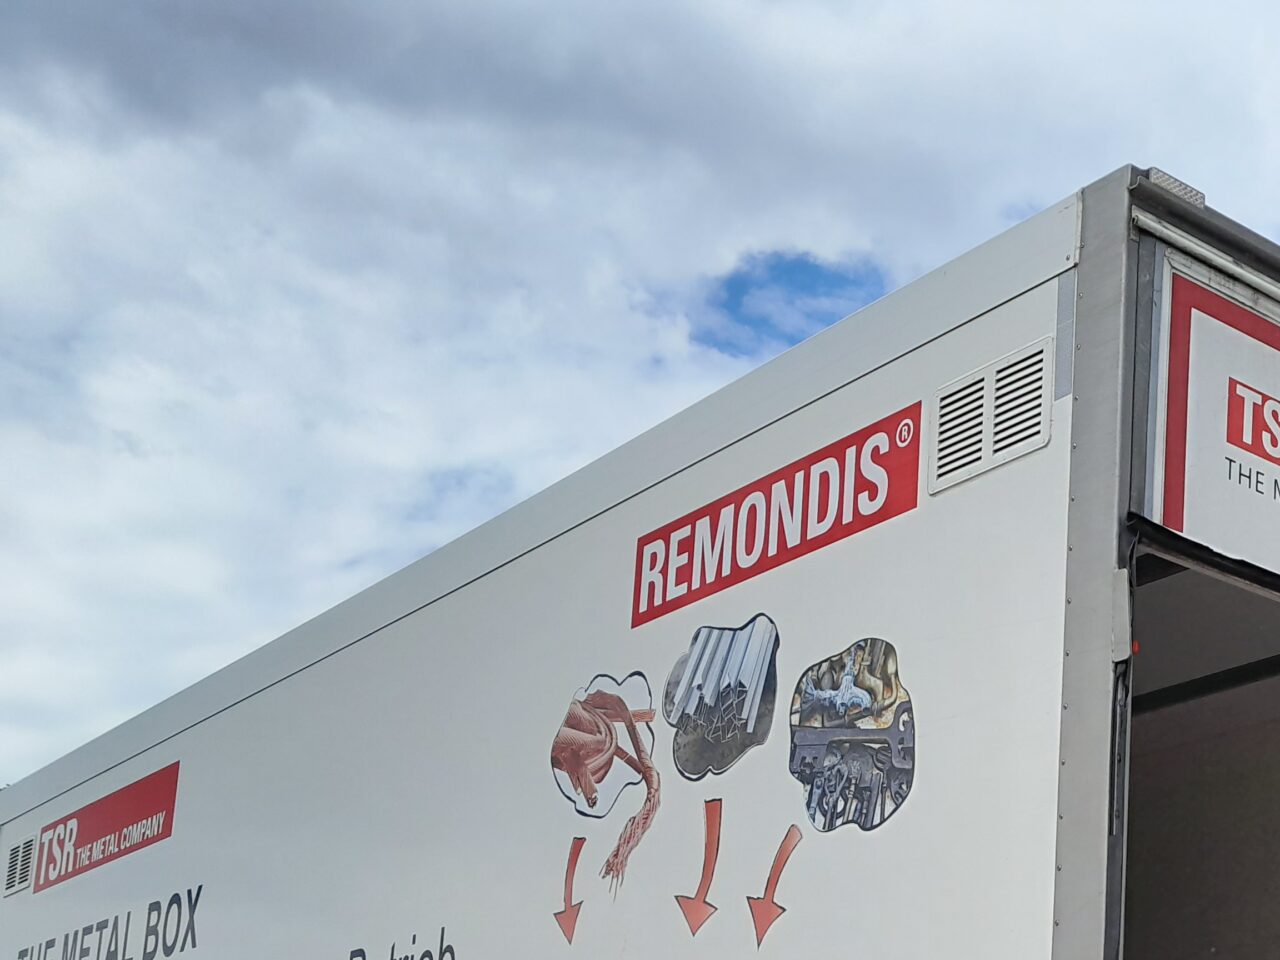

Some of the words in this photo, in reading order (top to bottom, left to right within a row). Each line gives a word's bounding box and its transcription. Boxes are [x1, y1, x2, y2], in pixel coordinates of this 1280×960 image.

[1225, 456, 1265, 495] THE
[39, 817, 78, 885] TSR
[76, 843, 93, 869] THE
[91, 831, 119, 862] METAL
[120, 810, 166, 850] COMPANY
